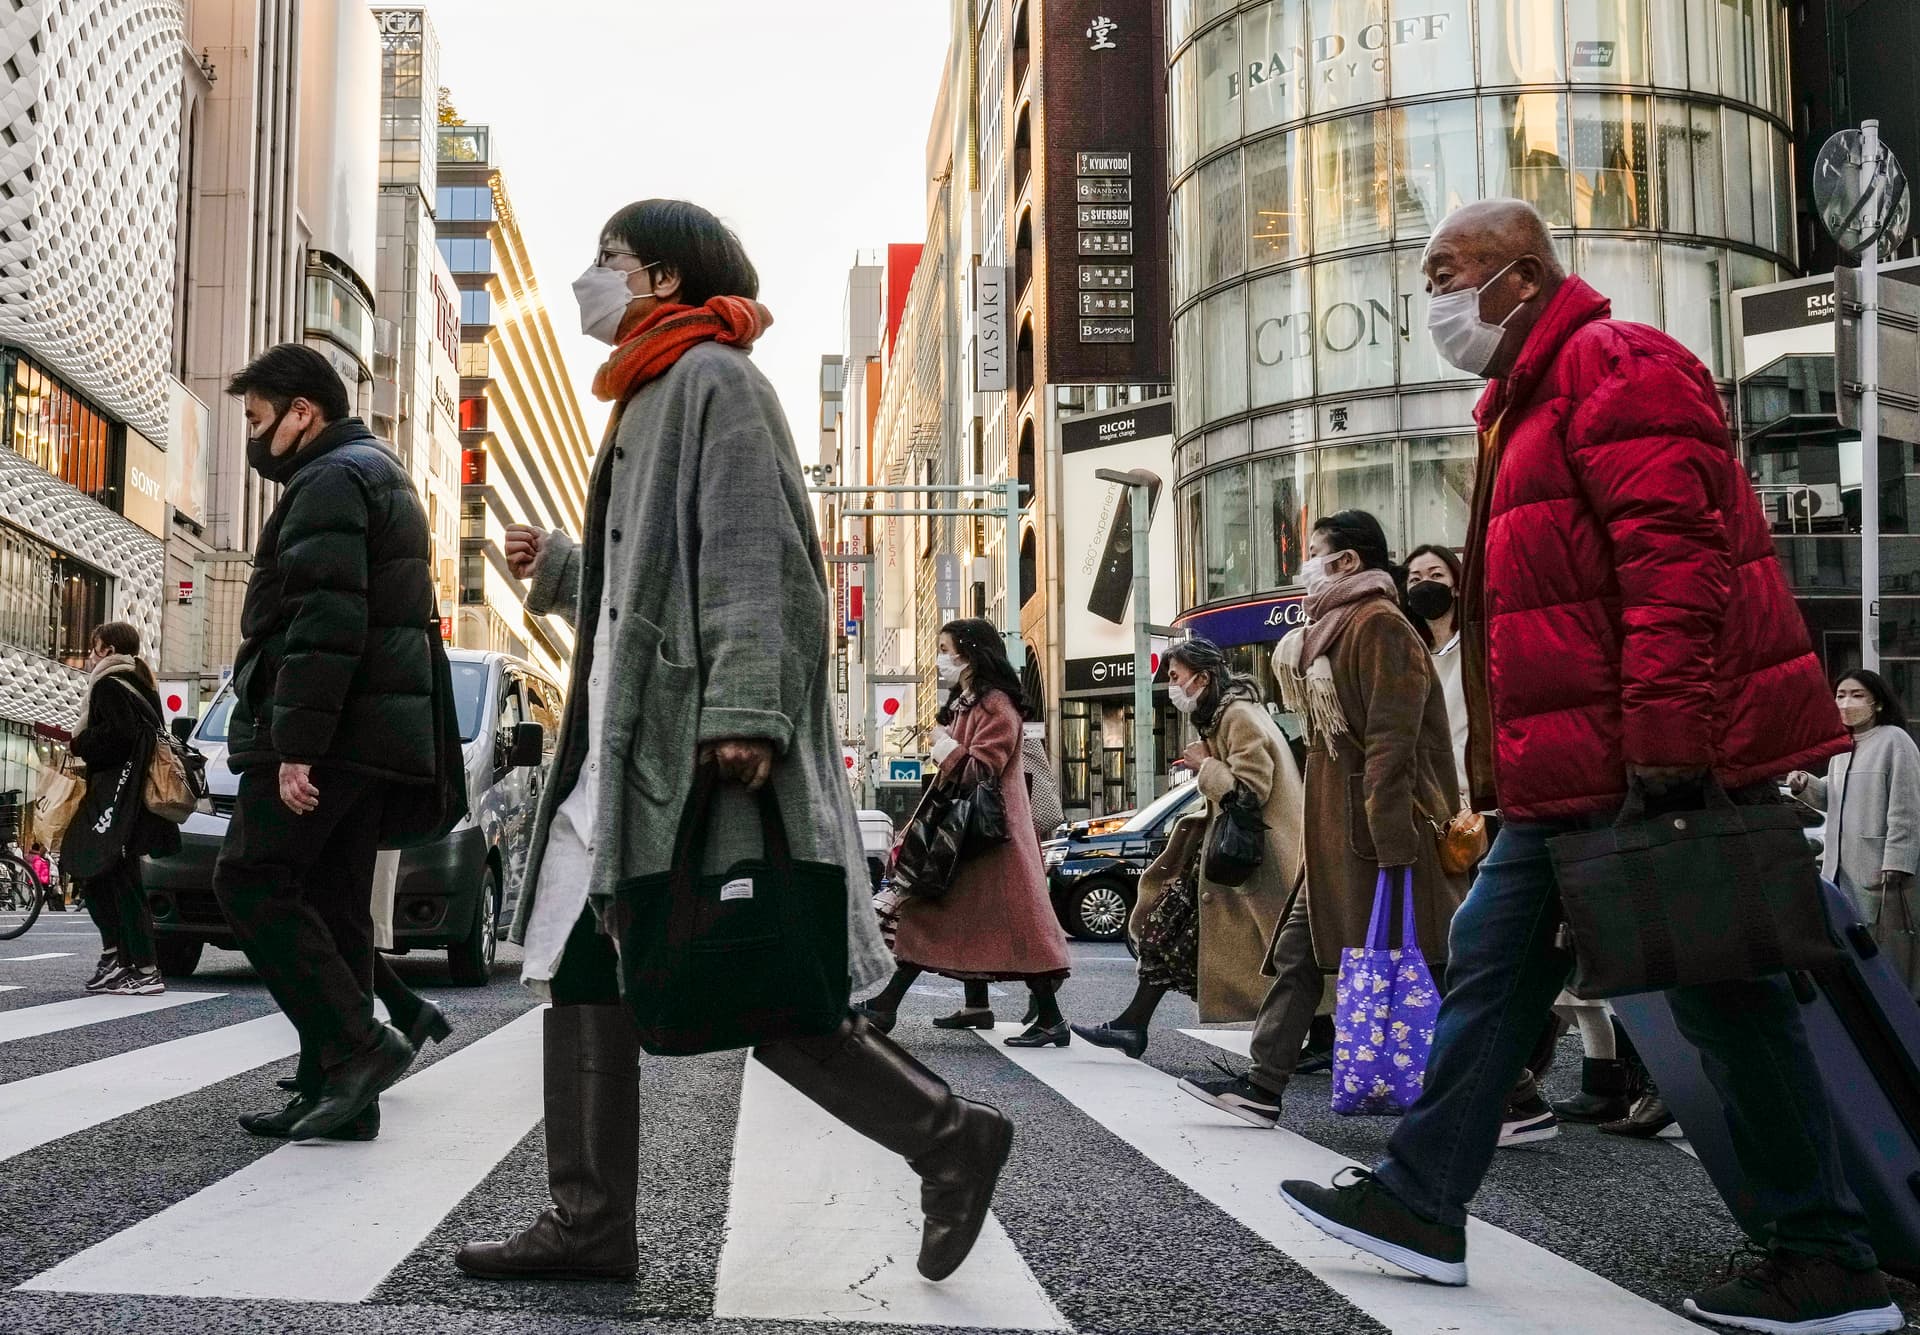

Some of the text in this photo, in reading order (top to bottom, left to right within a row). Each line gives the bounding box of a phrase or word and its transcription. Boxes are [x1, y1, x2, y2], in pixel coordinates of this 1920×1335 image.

[1087, 16, 1118, 50] 堂
[1357, 13, 1450, 51] OFF
[1089, 158, 1128, 170] KYUKYODO
[1080, 185, 1089, 195] 6
[1081, 209, 1129, 222] 5 SVENSON
[1082, 238, 1090, 249] 4
[1082, 272, 1091, 282] 3
[983, 281, 999, 378] TASAKI
[1082, 325, 1092, 336] B
[1099, 418, 1135, 434] RICOH
[131, 466, 161, 501] SONY
[1263, 605, 1284, 626] Le
